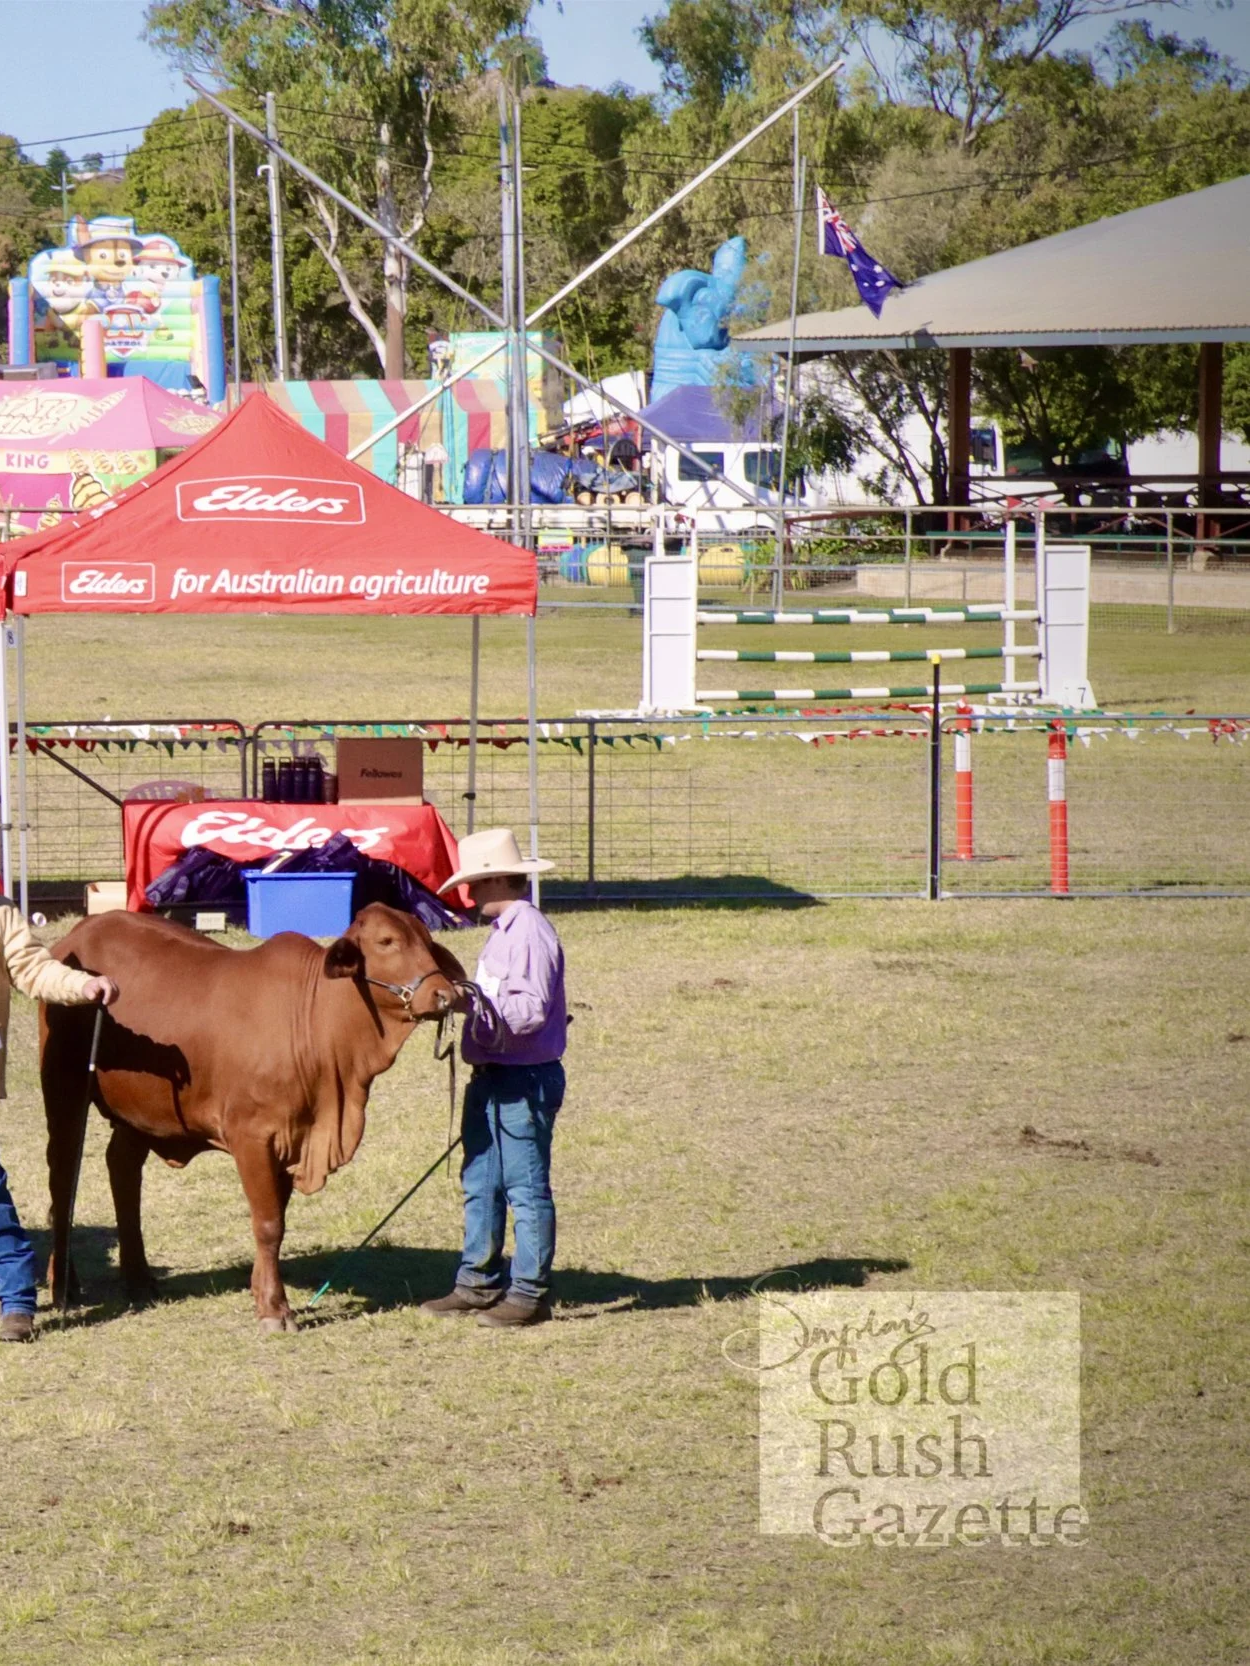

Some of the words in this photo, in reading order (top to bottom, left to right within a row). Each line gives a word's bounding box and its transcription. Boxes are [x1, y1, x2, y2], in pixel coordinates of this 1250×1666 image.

[6, 454, 49, 469] KING
[192, 485, 350, 514] Elders
[69, 569, 148, 595] Elders
[170, 567, 211, 600] for
[211, 568, 345, 594] Australian
[349, 568, 490, 600] agriculture
